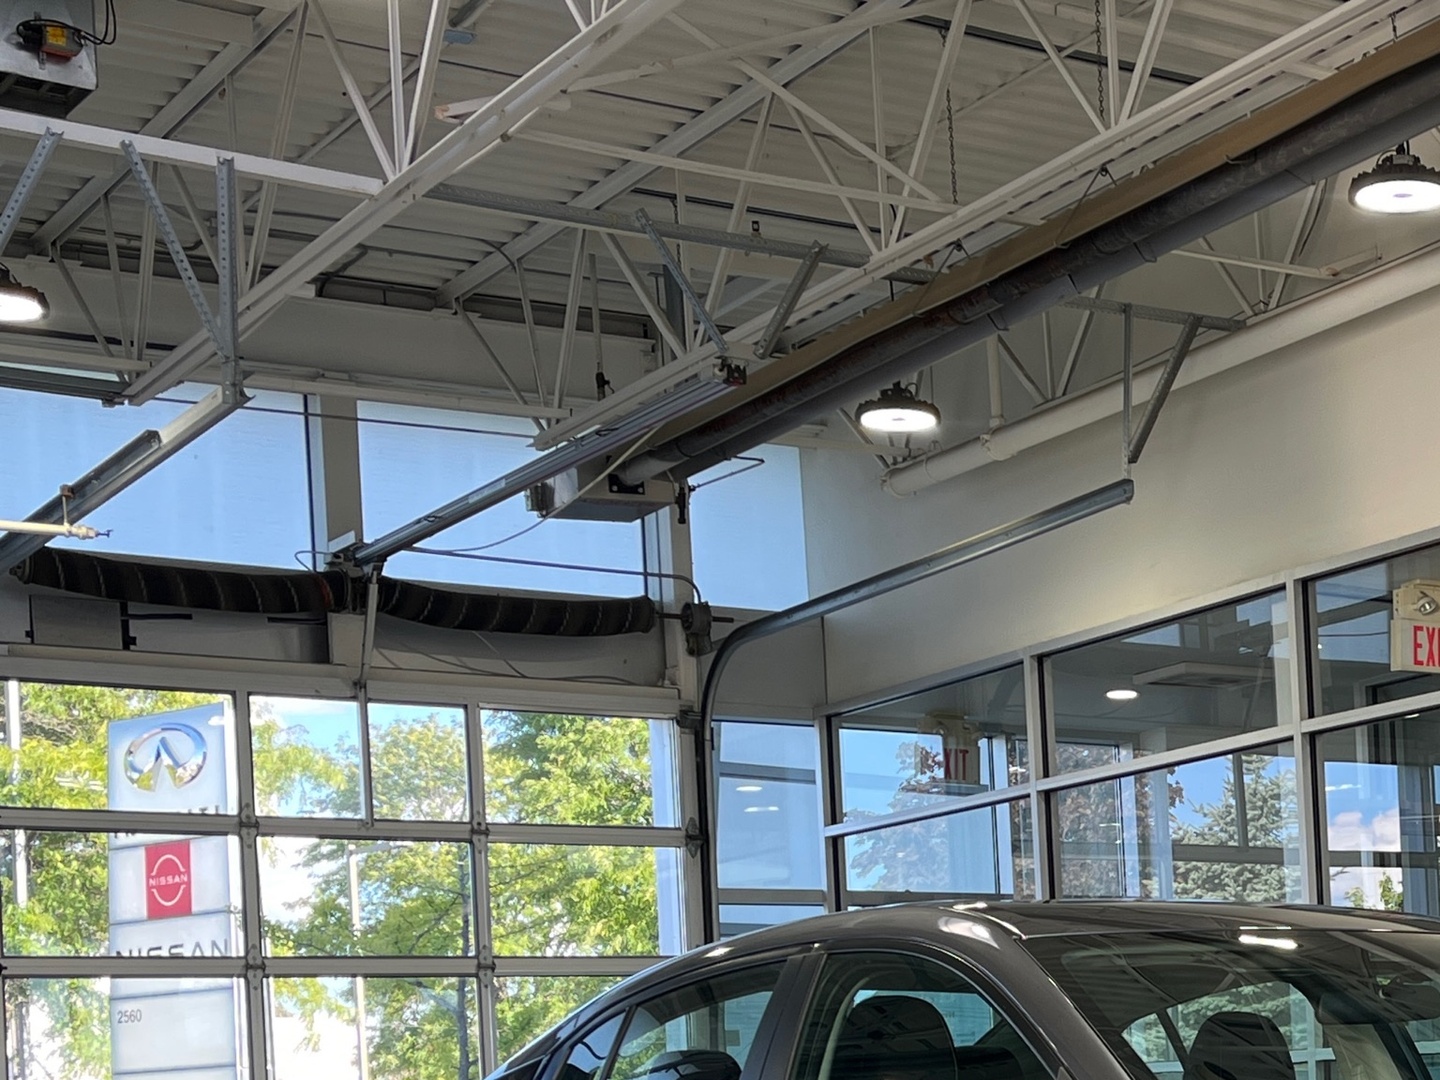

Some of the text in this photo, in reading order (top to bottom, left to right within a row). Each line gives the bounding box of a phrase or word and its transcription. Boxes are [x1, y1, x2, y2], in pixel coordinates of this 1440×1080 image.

[936, 748, 969, 781] XIT
[149, 873, 188, 887] NISSAN
[116, 938, 228, 957] SAN
[117, 1009, 142, 1024] 2560
